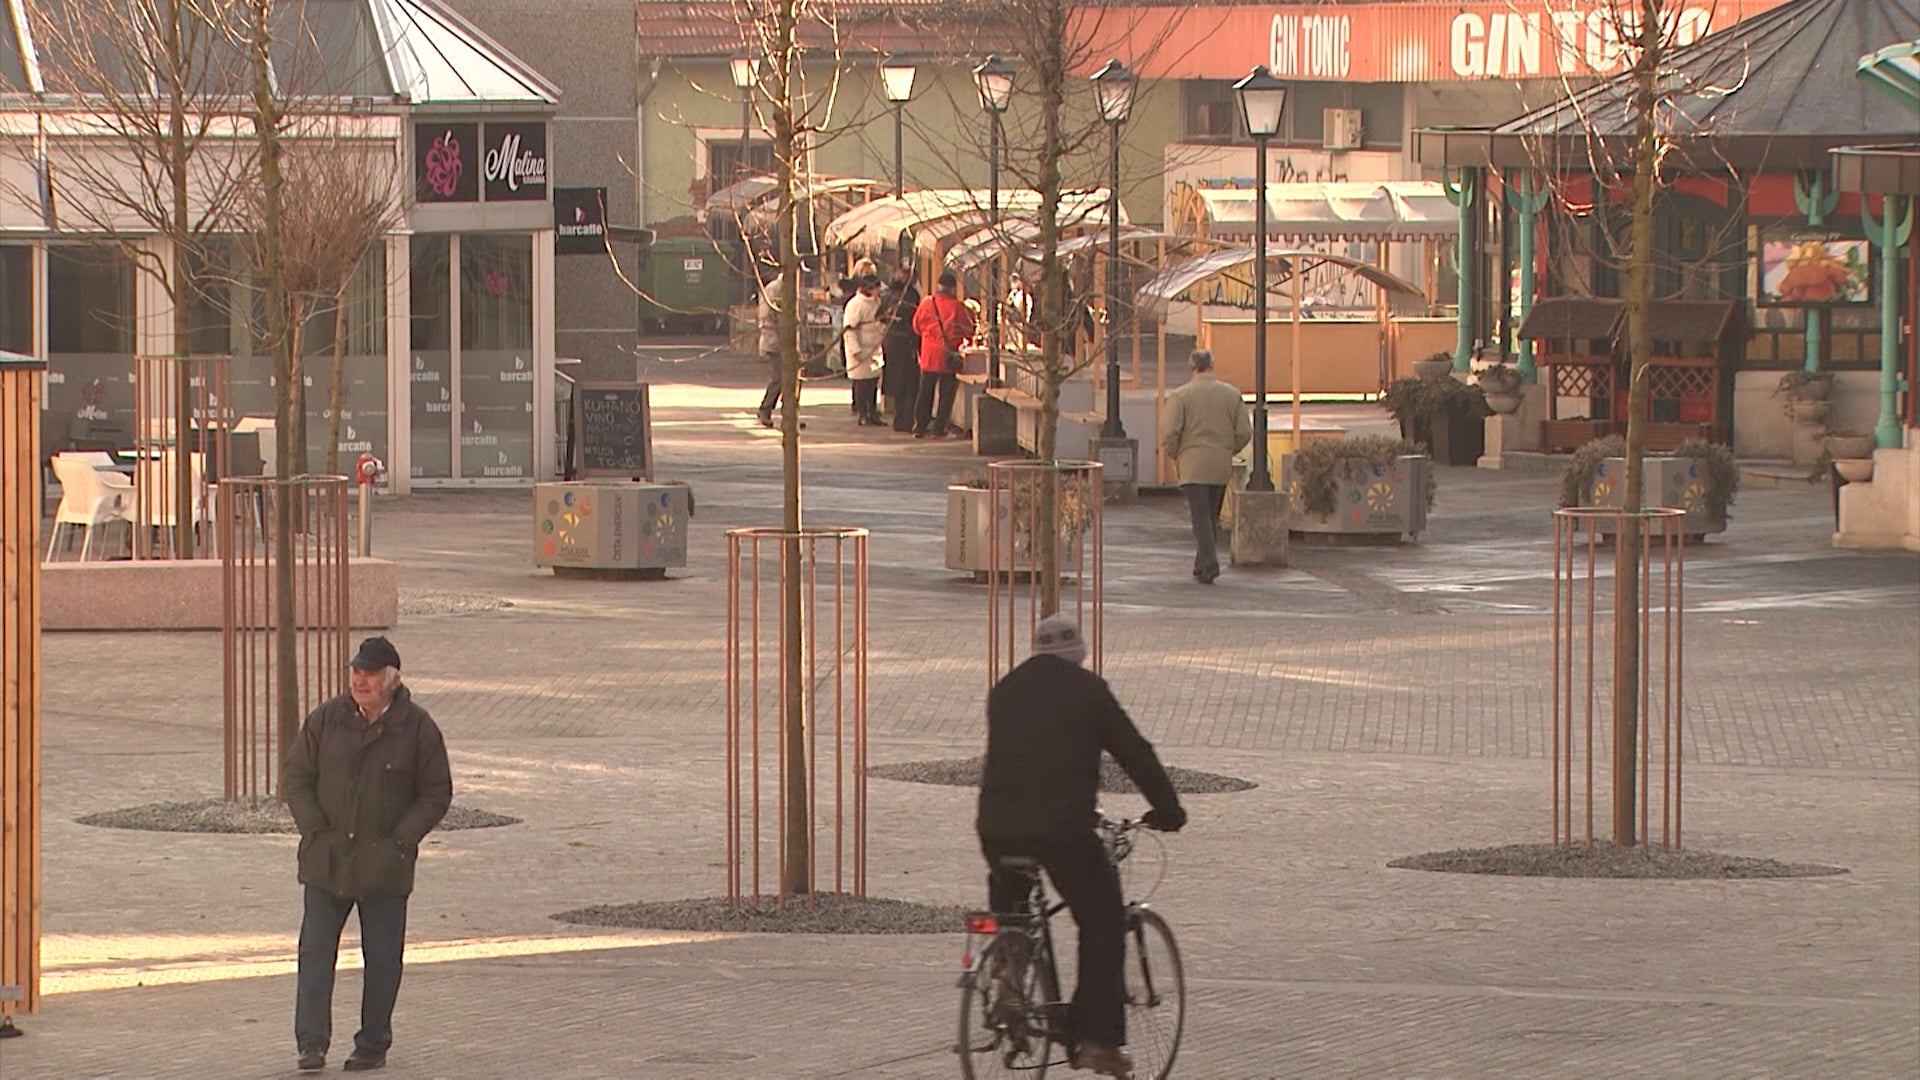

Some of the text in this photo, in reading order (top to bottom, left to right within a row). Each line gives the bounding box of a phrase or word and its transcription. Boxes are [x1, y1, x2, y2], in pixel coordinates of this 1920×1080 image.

[1269, 14, 1350, 77] GIN TONIC
[1451, 13, 1540, 76] GIN
[485, 134, 545, 191] Malina
